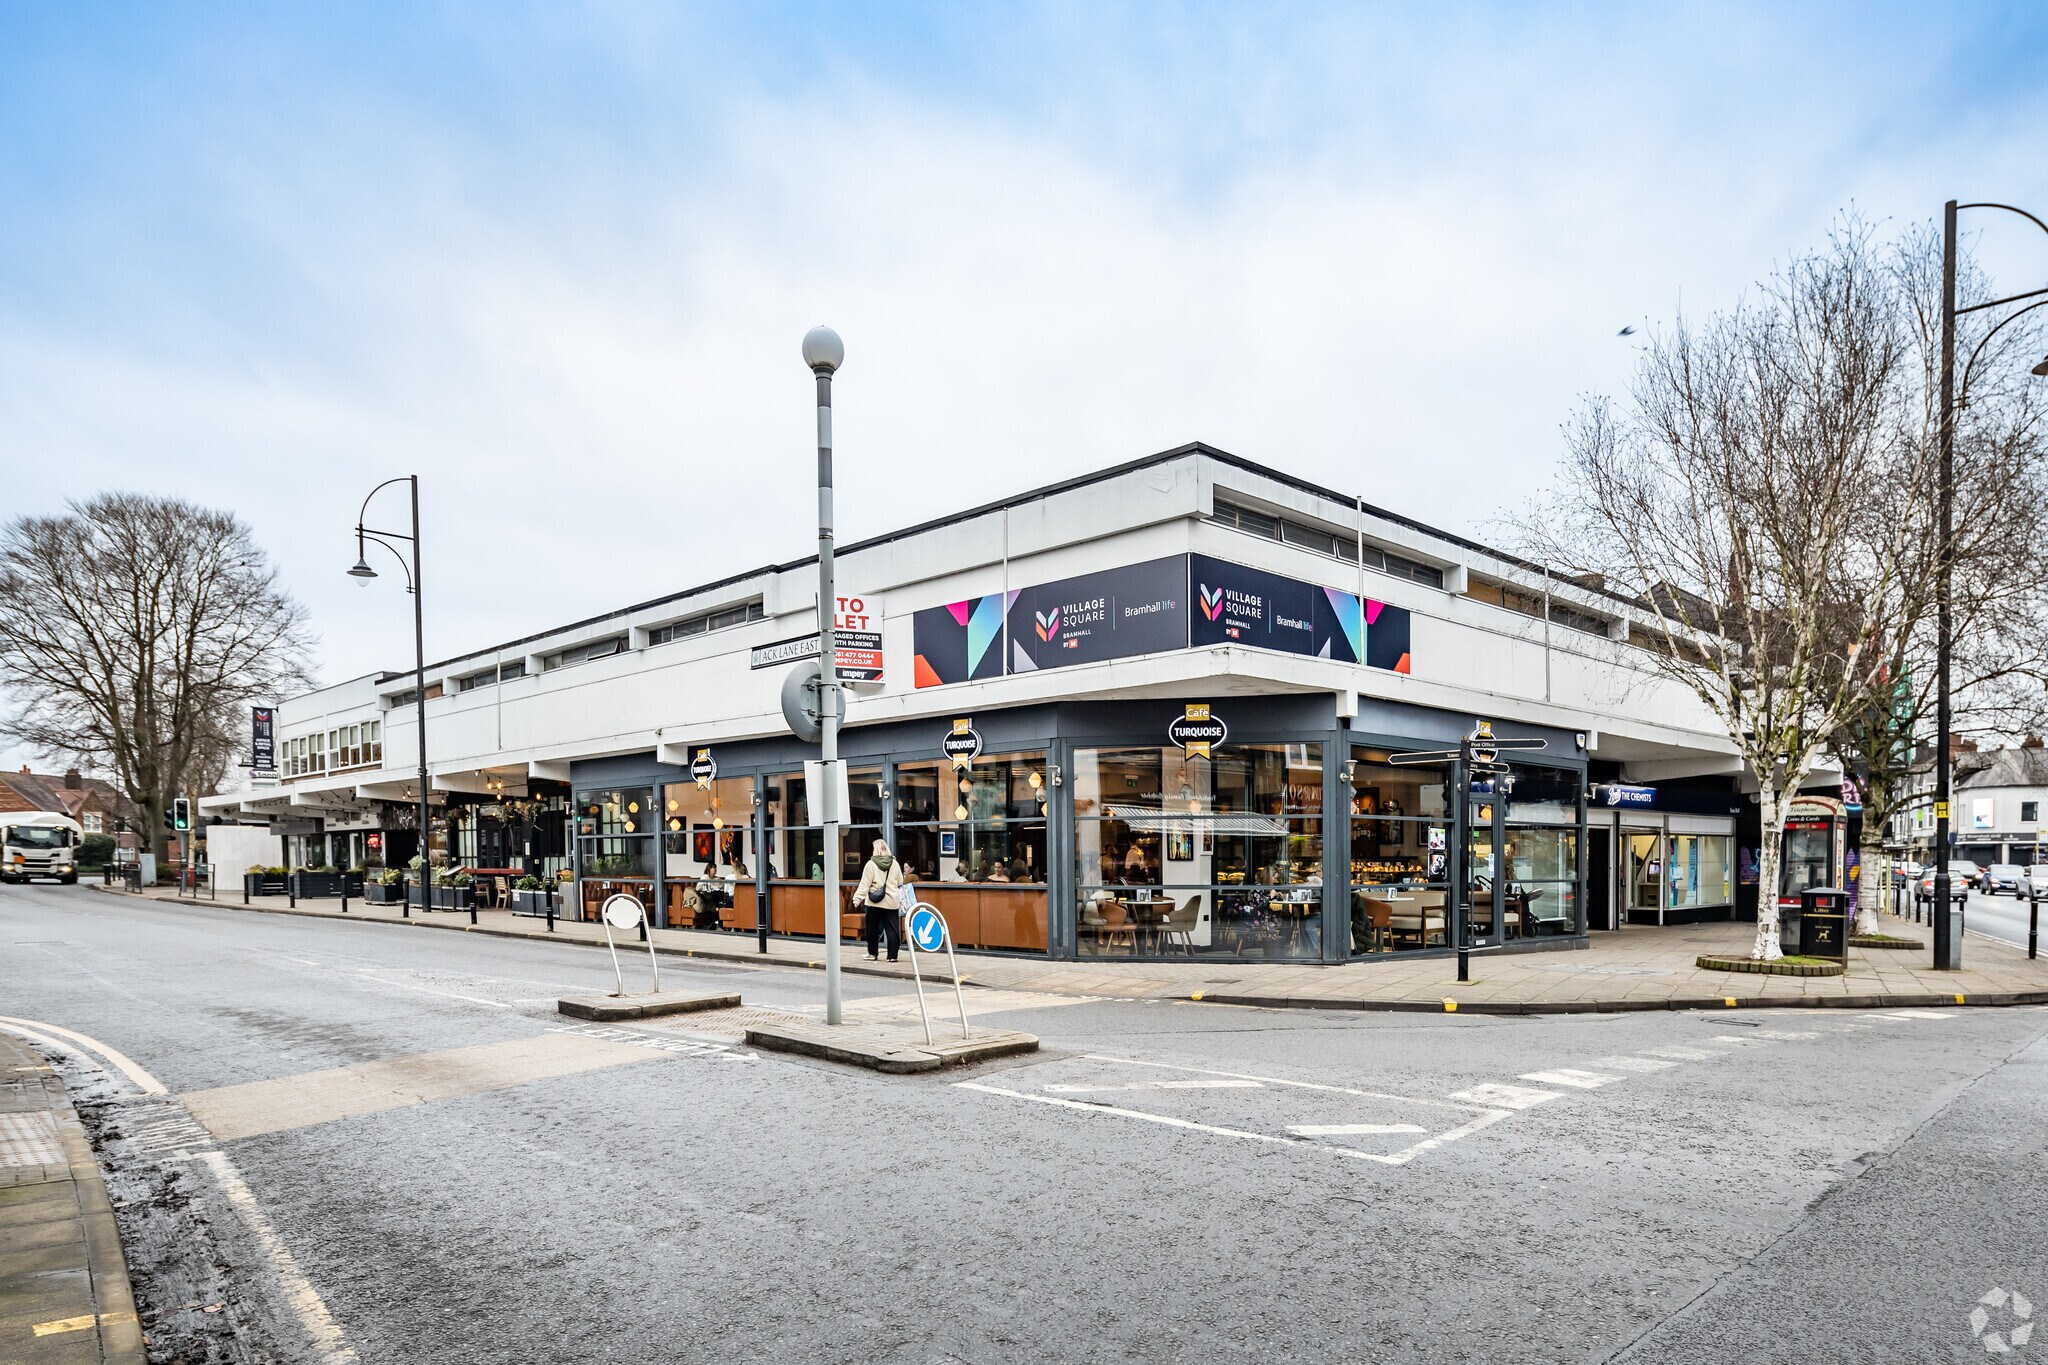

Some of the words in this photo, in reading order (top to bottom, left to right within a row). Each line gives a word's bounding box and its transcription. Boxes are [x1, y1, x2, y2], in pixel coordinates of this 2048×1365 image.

[836, 597, 864, 613] TO
[1226, 588, 1262, 606] VILLAGE
[1062, 598, 1105, 614] VILLAGE
[1125, 601, 1161, 617] Bramhall
[1162, 600, 1176, 610] life
[1226, 602, 1262, 618] SQUARE
[834, 614, 869, 630] LET
[1062, 610, 1105, 627] SQUARE
[1226, 618, 1250, 629] BRAMHALL
[1276, 615, 1302, 629] Bramhall
[1303, 621, 1312, 632] life
[1062, 629, 1091, 639] BRAMHALL
[762, 648, 778, 662] ACK
[780, 644, 798, 658] LANE
[800, 640, 819, 653] EAST
[842, 669, 865, 679] impey
[1174, 727, 1222, 737] TURQUOISE
[946, 740, 975, 750] TURQUOISE
[1622, 792, 1630, 800] THE
[1631, 792, 1652, 802] CHEMISTS
[1936, 804, 1948, 816] H
